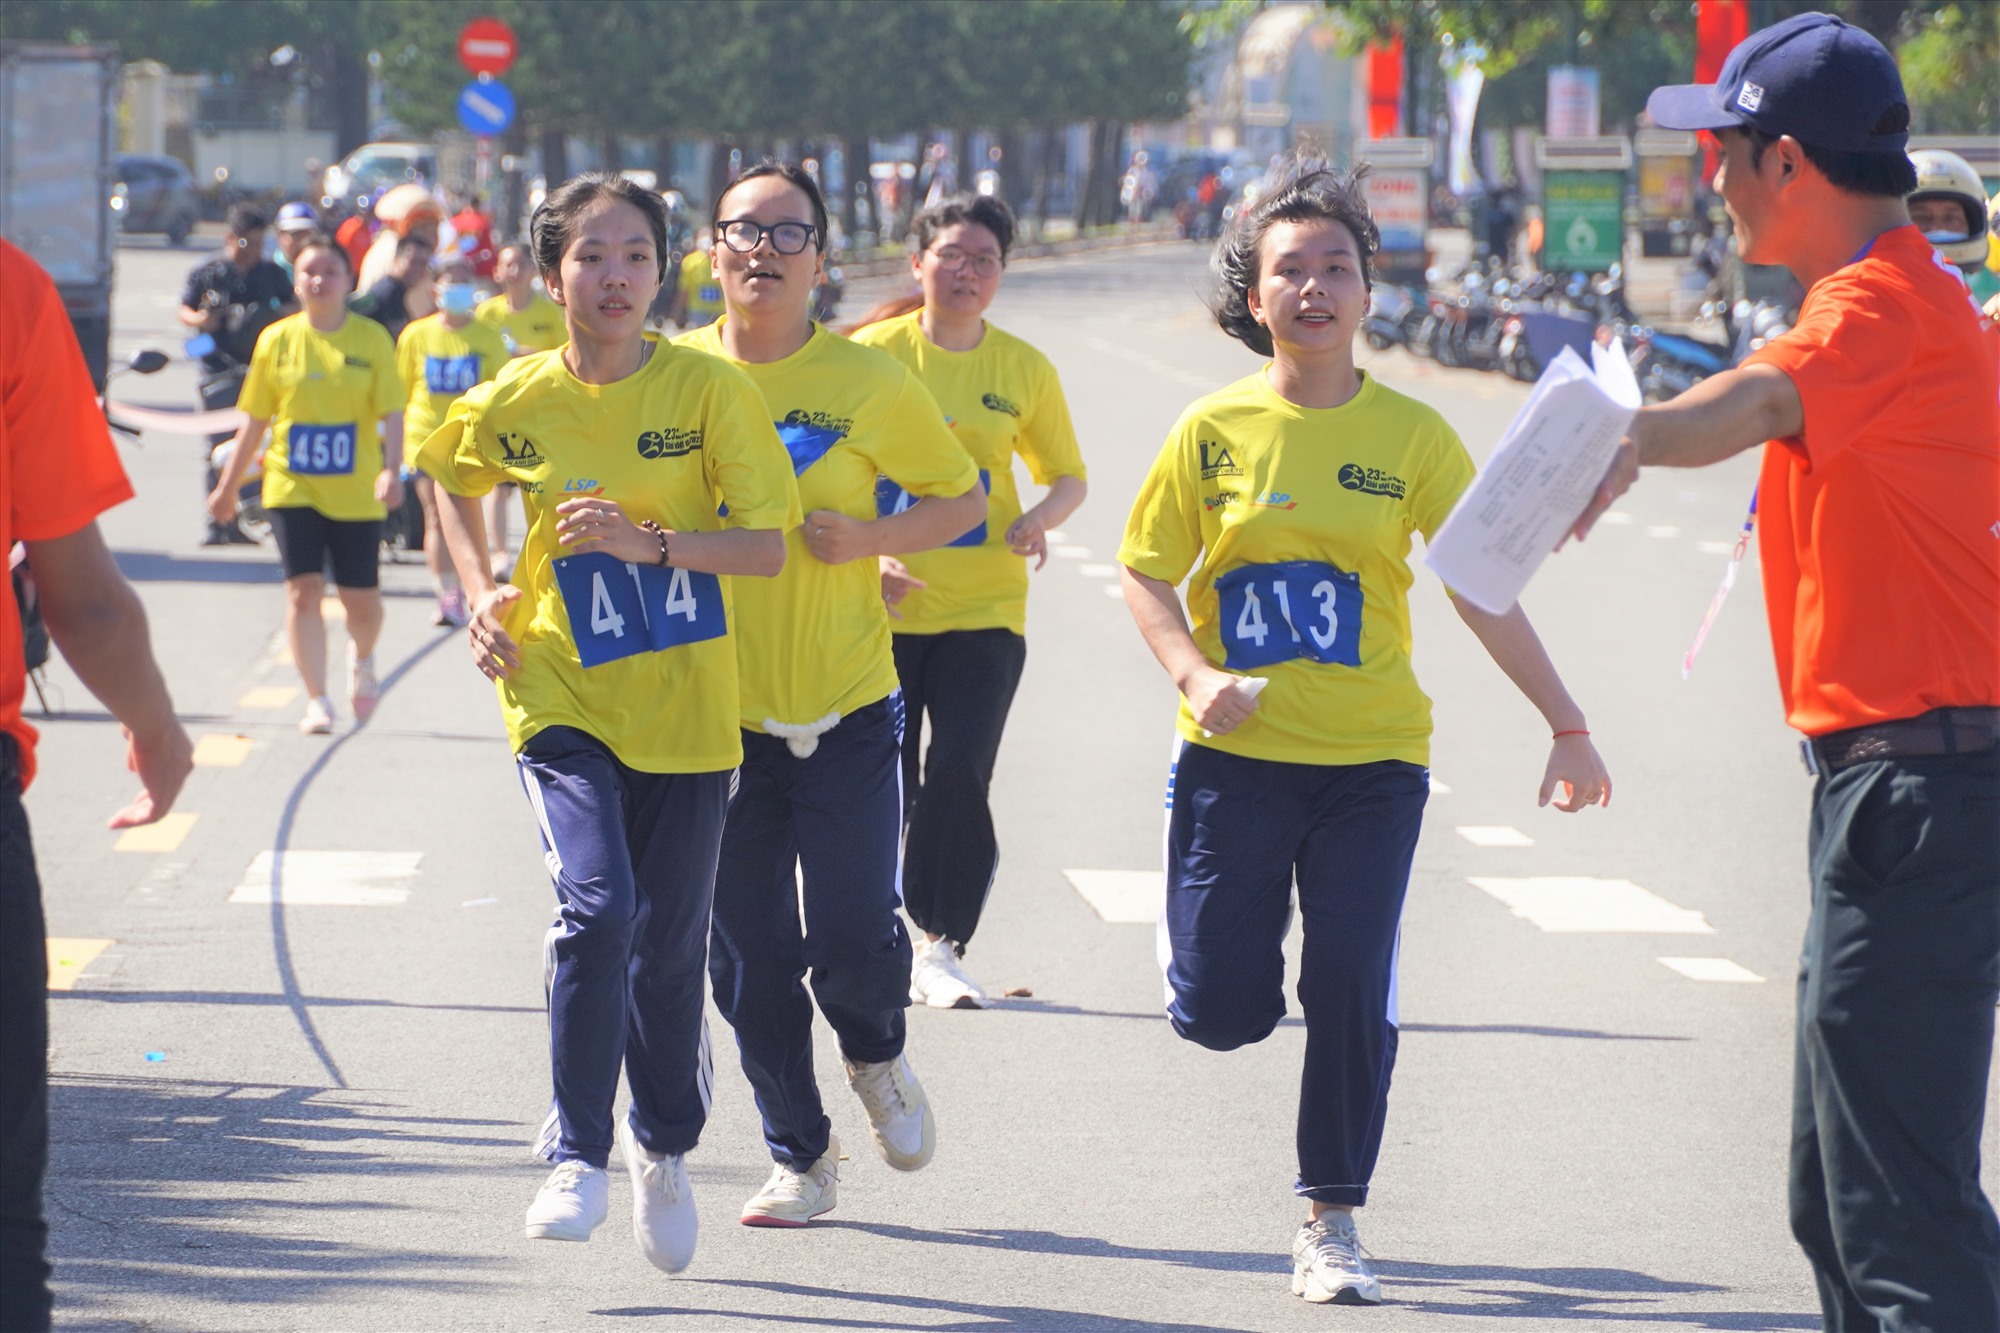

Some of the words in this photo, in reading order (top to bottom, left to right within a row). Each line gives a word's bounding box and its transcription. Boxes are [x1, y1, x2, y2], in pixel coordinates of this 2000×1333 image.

[293, 431, 351, 469] 450
[564, 479, 599, 492] LSP
[1256, 491, 1291, 504] LSP
[1236, 580, 1339, 649] 413
